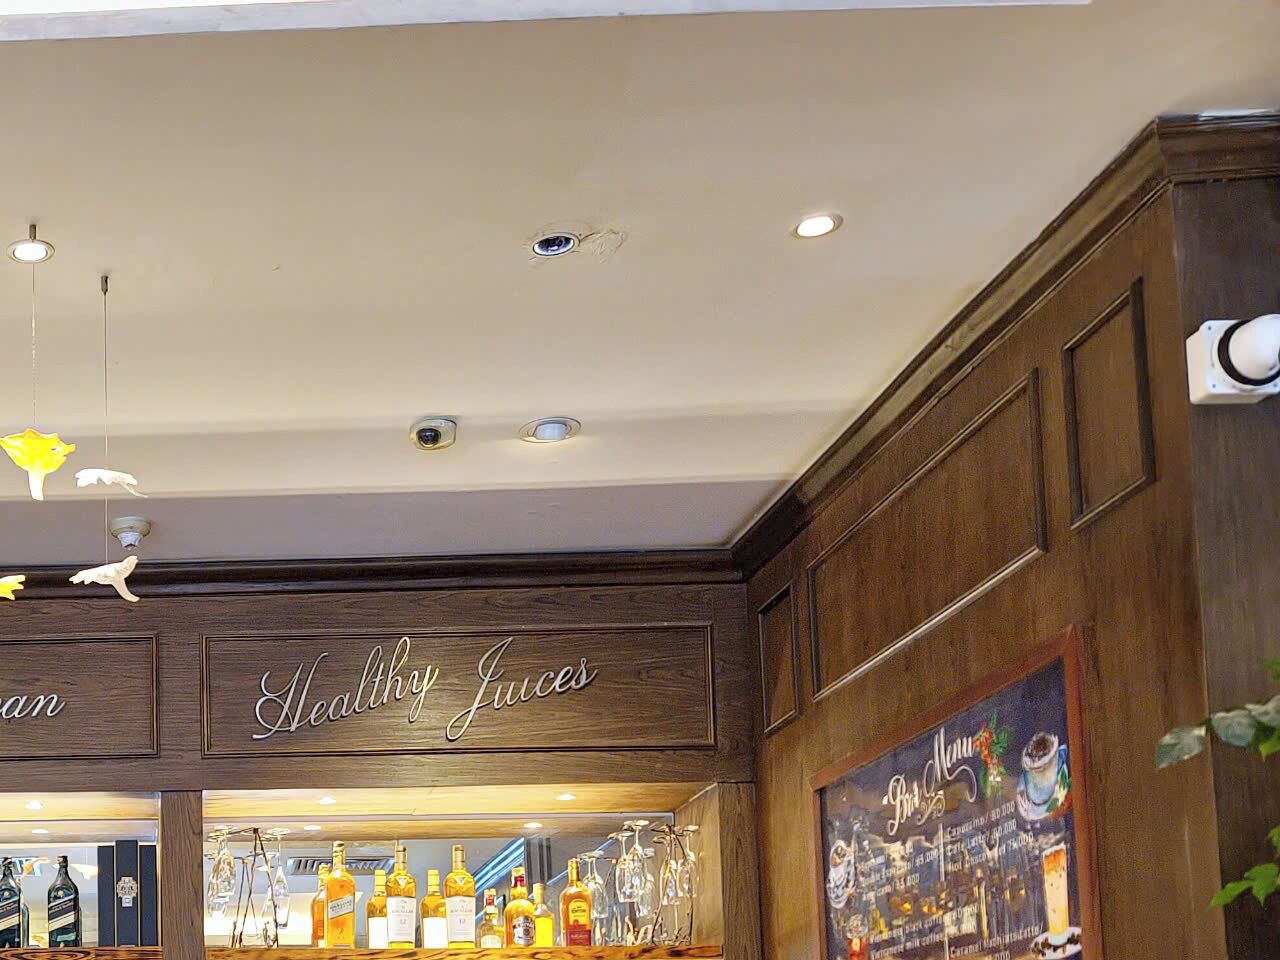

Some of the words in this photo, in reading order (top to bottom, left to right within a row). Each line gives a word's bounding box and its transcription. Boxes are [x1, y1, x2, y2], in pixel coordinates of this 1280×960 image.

[252, 637, 439, 740] Healthy
[445, 637, 600, 741] Juices
[923, 727, 977, 803] Menu
